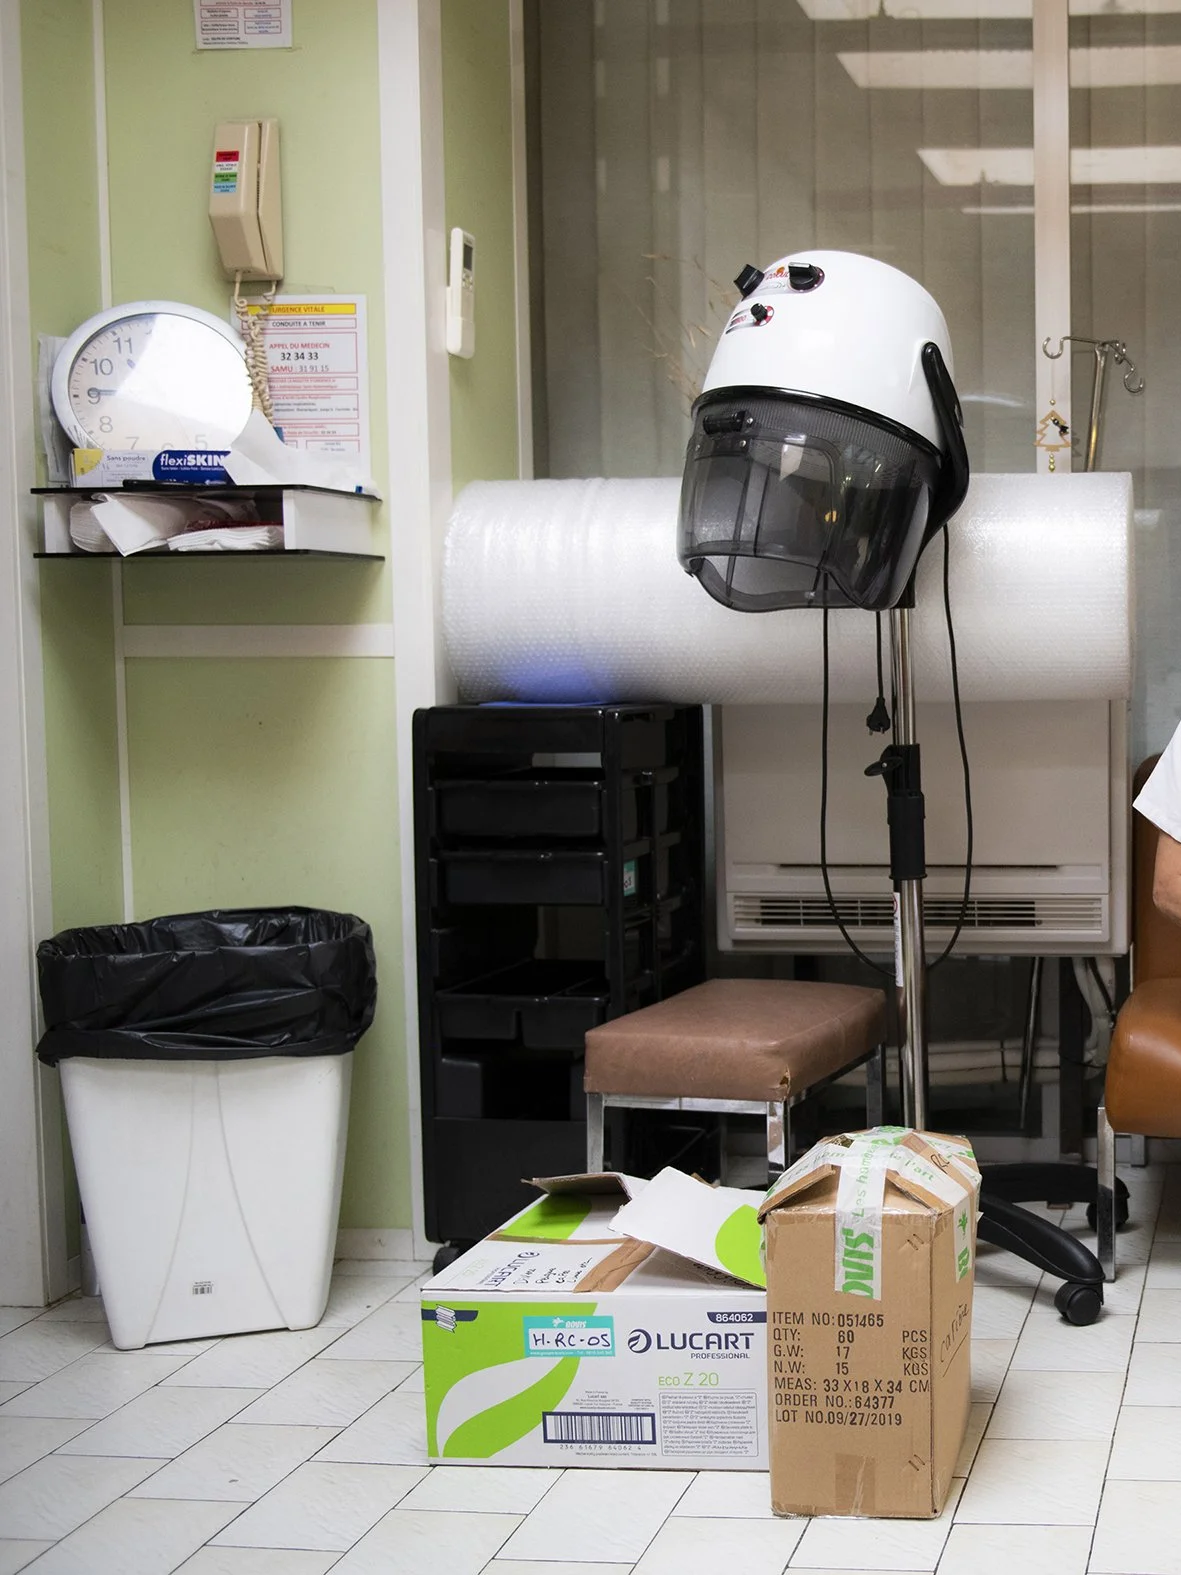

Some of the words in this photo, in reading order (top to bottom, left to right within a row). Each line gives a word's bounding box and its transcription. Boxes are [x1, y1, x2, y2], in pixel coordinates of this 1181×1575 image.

[113, 337, 133, 354] 11
[281, 352, 291, 361] 32
[294, 352, 305, 361] 34
[308, 352, 319, 361] 33
[90, 358, 113, 376] 10
[87, 387, 101, 405] 9
[99, 416, 113, 433] 8
[106, 454, 122, 462] Sans
[123, 454, 146, 463] poudre
[715, 1313, 754, 1322] 864062
[772, 1311, 804, 1325] ITEM
[656, 1332, 755, 1350] LUCART
[773, 1327, 801, 1342] QTY:
[838, 1329, 855, 1344] 60
[902, 1329, 928, 1343] PCS
[690, 1352, 750, 1360] PROFESSIONAL
[773, 1344, 804, 1358] G.W:
[836, 1346, 850, 1359] 17
[902, 1346, 928, 1361] KGS
[774, 1360, 805, 1374] N.W:
[836, 1362, 849, 1375] 15
[903, 1361, 929, 1376] KGS
[658, 1376, 681, 1386] ECO
[683, 1372, 694, 1386] Z
[698, 1372, 719, 1386] 20
[774, 1377, 817, 1391] MEAS:
[823, 1379, 839, 1393] 33
[886, 1380, 903, 1394] 34
[909, 1380, 929, 1393] CM
[775, 1393, 818, 1407] ORDER
[775, 1410, 798, 1423] LOT
